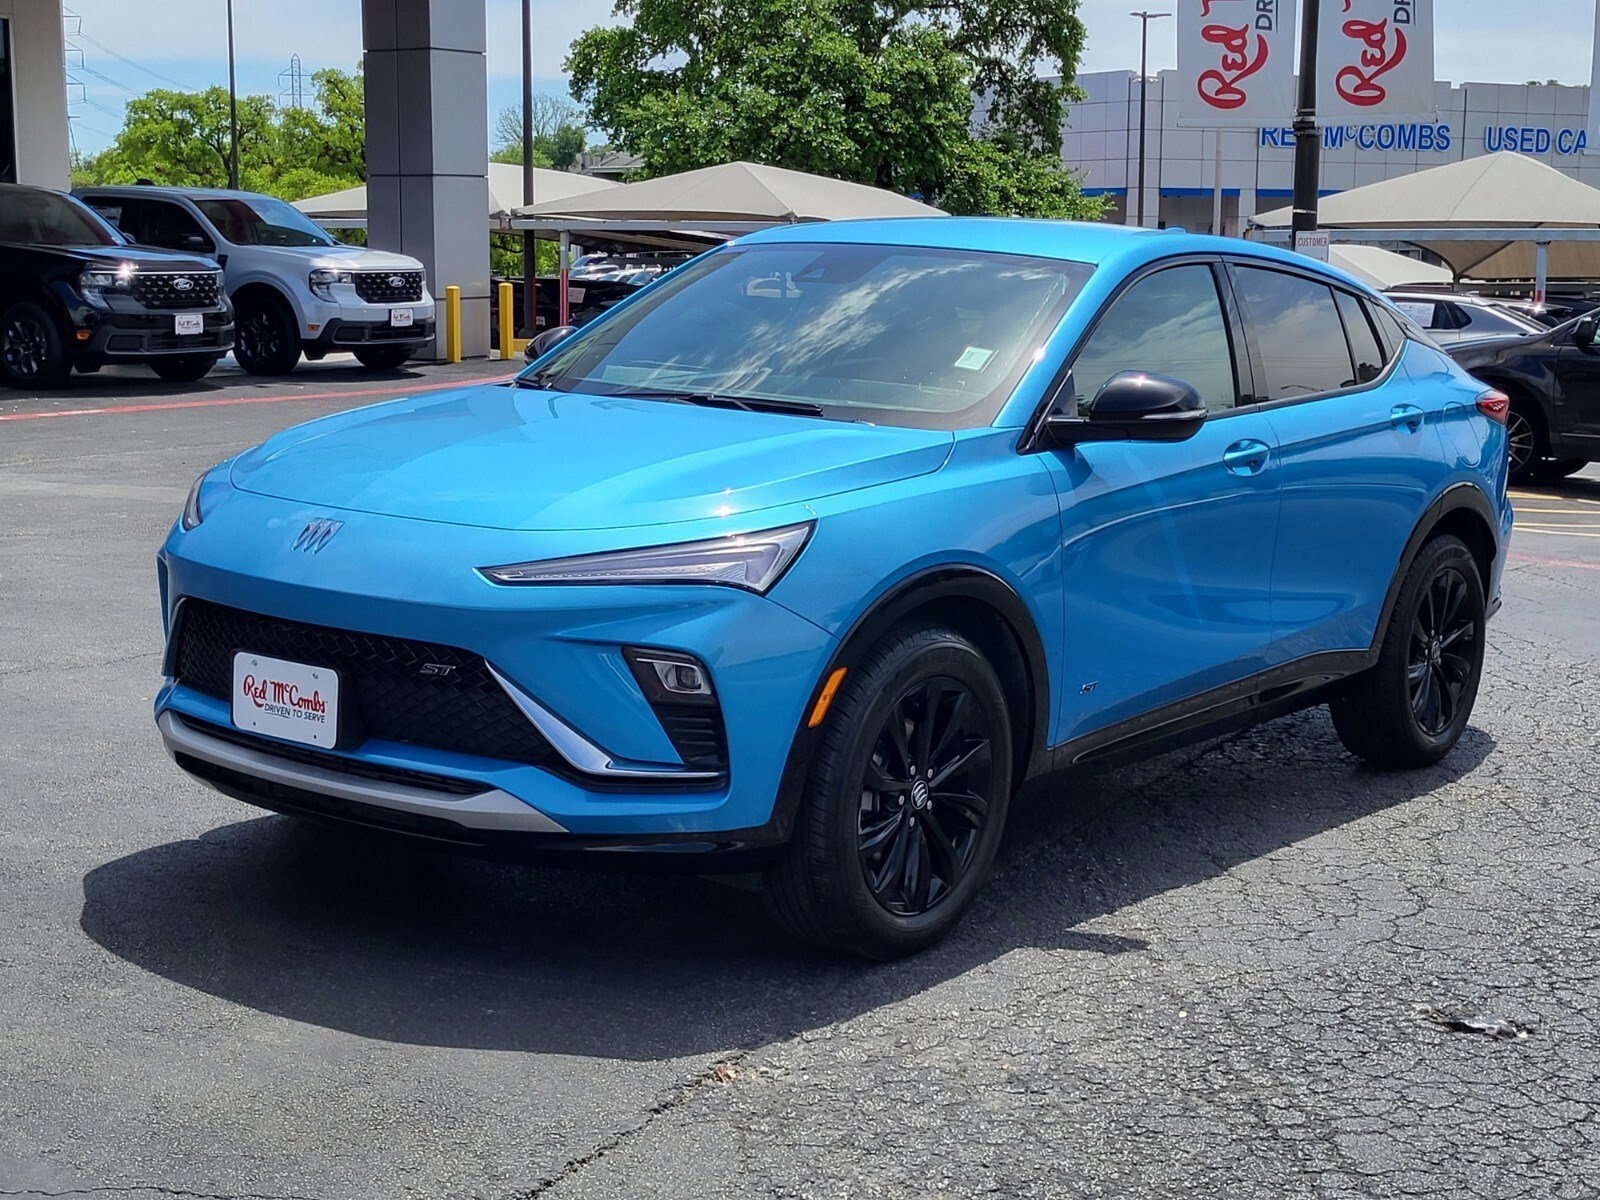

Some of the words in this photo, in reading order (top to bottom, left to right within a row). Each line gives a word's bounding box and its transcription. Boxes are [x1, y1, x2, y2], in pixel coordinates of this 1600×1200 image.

[1197, 24, 1269, 109] Red
[1335, 17, 1407, 107] Red
[1260, 127, 1297, 147] RE
[1486, 126, 1551, 152] USED
[1298, 237, 1328, 247] CUSTOMER
[420, 663, 456, 676] ST
[243, 674, 268, 708] Red
[269, 680, 325, 713] McCombs
[264, 703, 291, 716] DRIVEN
[292, 708, 303, 719] TO
[304, 711, 326, 723] SERVE
